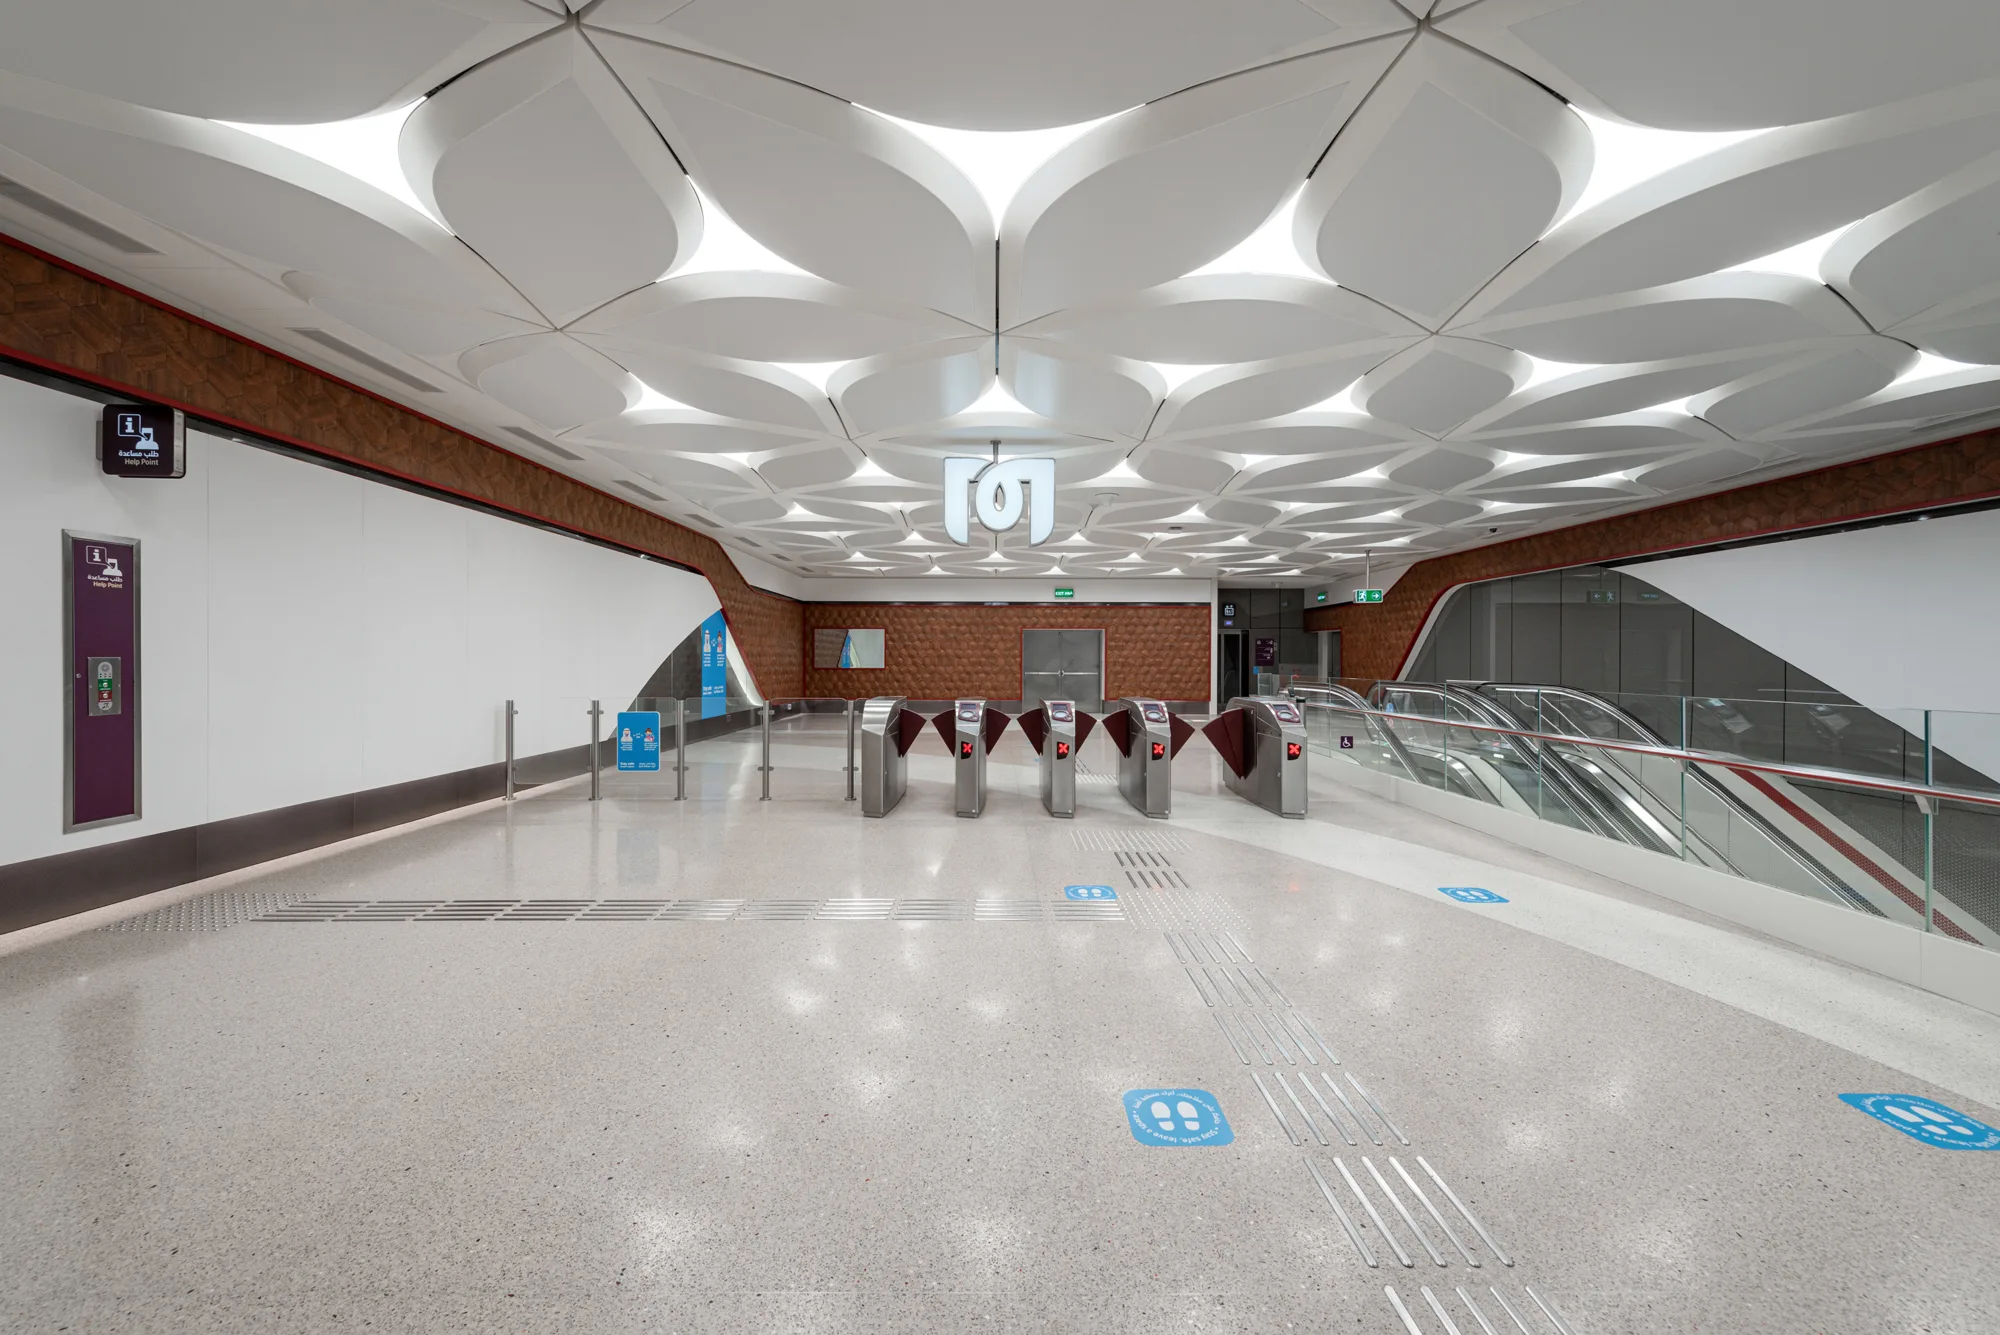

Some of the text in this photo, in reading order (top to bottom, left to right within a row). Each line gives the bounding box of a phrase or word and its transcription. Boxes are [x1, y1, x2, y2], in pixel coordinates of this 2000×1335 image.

[118, 449, 159, 459] طلب مساعدة
[124, 458, 140, 467] Help
[1132, 1114, 1148, 1129] space
[1200, 1130, 1218, 1140] Stay
